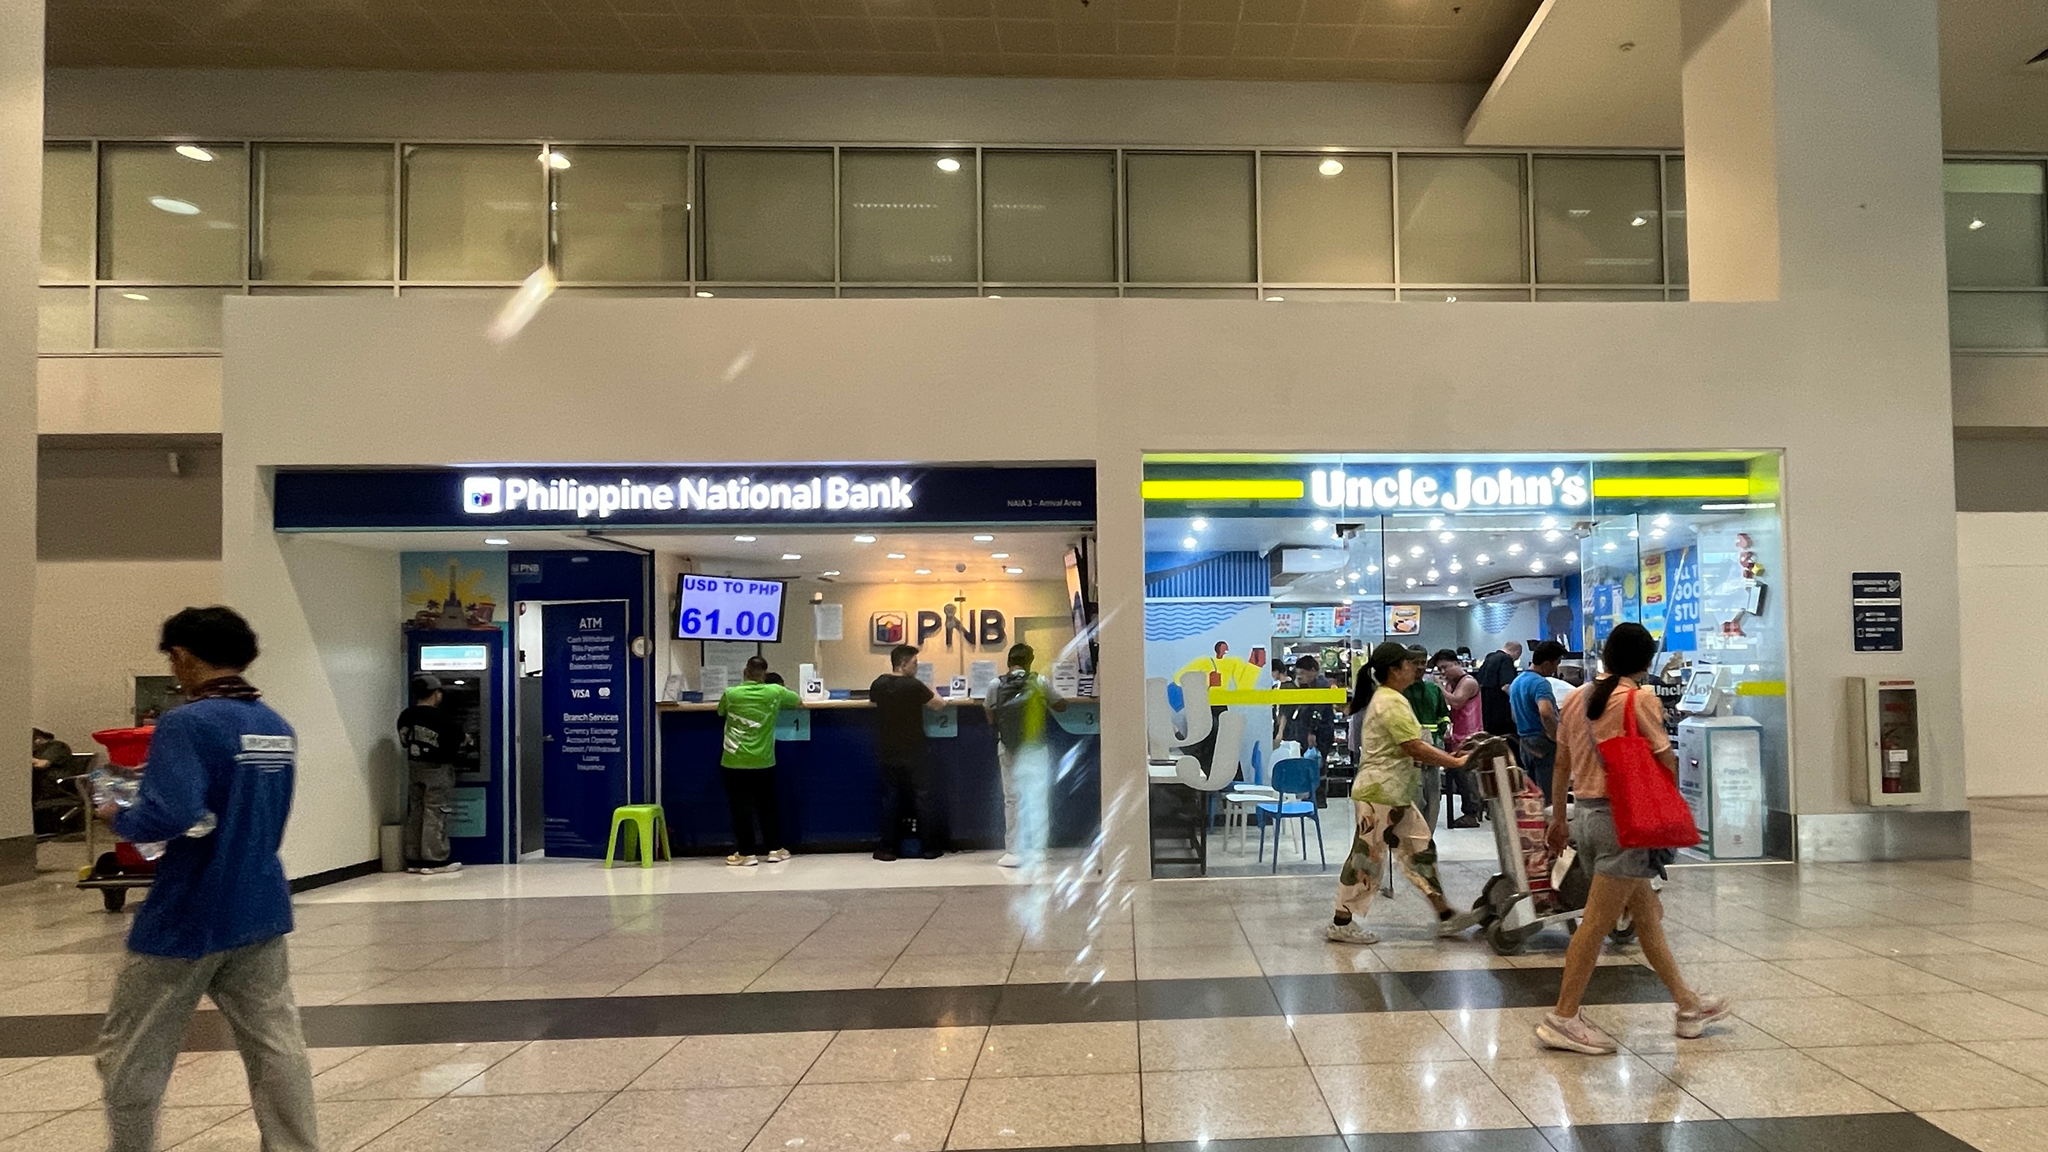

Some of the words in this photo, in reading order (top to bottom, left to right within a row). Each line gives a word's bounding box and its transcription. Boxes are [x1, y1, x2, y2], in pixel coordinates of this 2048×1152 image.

[1311, 468, 1439, 508] Uncle
[1441, 466, 1587, 511] John's
[505, 478, 674, 518] Philippine
[679, 477, 821, 509] National
[827, 476, 914, 510] Bank
[1007, 499, 1027, 507] NAIA
[1027, 499, 1033, 507] 3
[1063, 499, 1082, 507] Area
[520, 563, 540, 572] PNB
[684, 578, 718, 592] USD
[723, 581, 744, 594] TO
[748, 583, 779, 596] PHP
[579, 617, 603, 629] ATM
[681, 607, 776, 637] 61.00
[917, 609, 1006, 645] PNB
[584, 644, 610, 653] Payment
[586, 653, 610, 661] Transfer
[571, 689, 590, 698] VISA
[563, 712, 588, 722] Branch
[588, 712, 619, 722] Services
[939, 714, 949, 729] 2
[1085, 711, 1094, 726] 3
[793, 718, 800, 732] 1
[563, 727, 589, 736] Currency
[590, 727, 619, 736] Exchange
[590, 736, 617, 745] Opening
